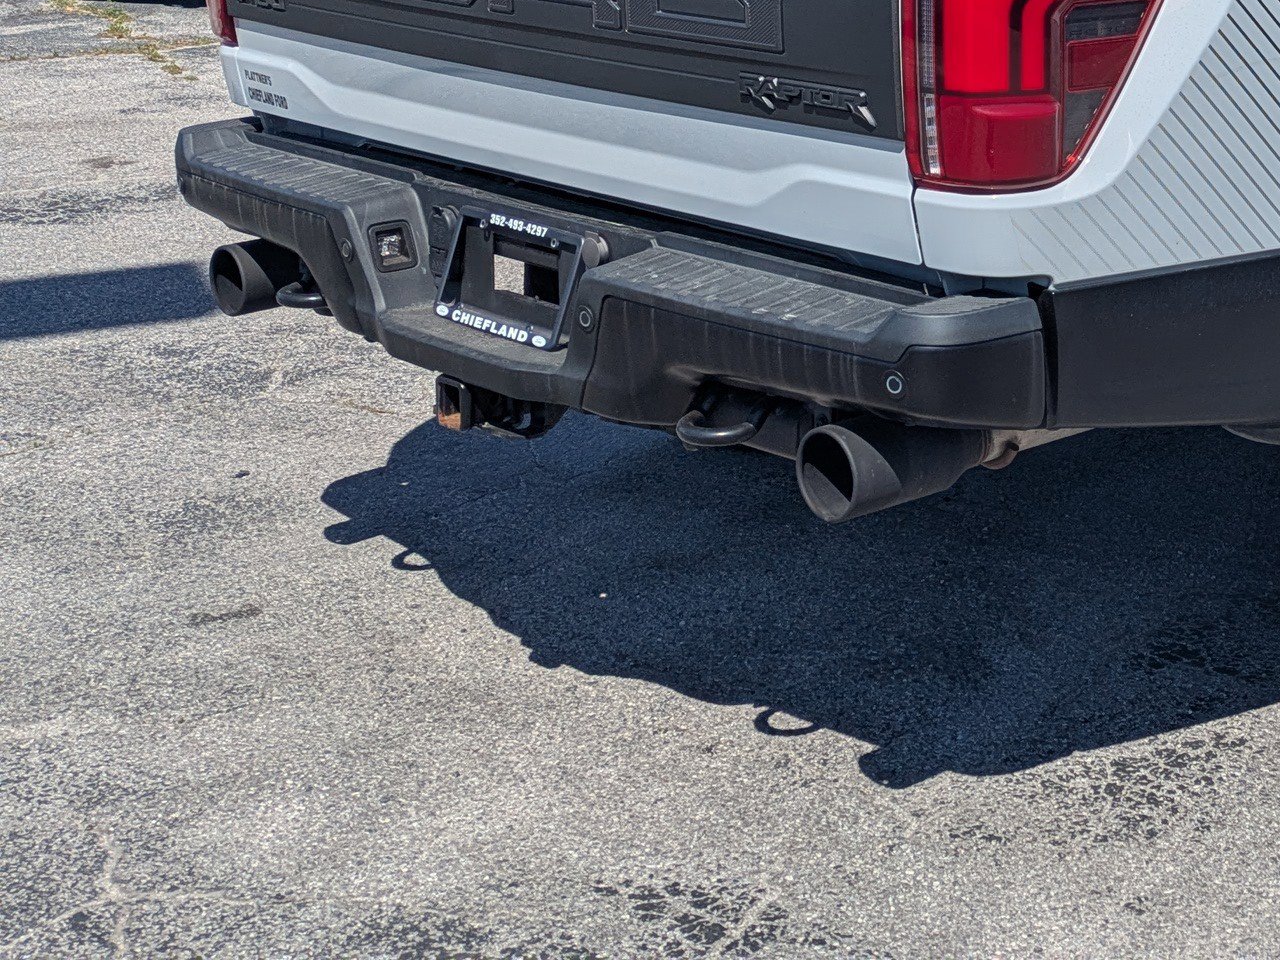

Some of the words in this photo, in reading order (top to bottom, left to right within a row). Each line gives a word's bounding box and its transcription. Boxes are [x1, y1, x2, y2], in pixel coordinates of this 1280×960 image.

[273, 93, 288, 110] FORD
[739, 71, 877, 132] RAPTOR
[490, 213, 548, 238] 352-493-4297
[451, 309, 529, 343] CHIEFLAND
